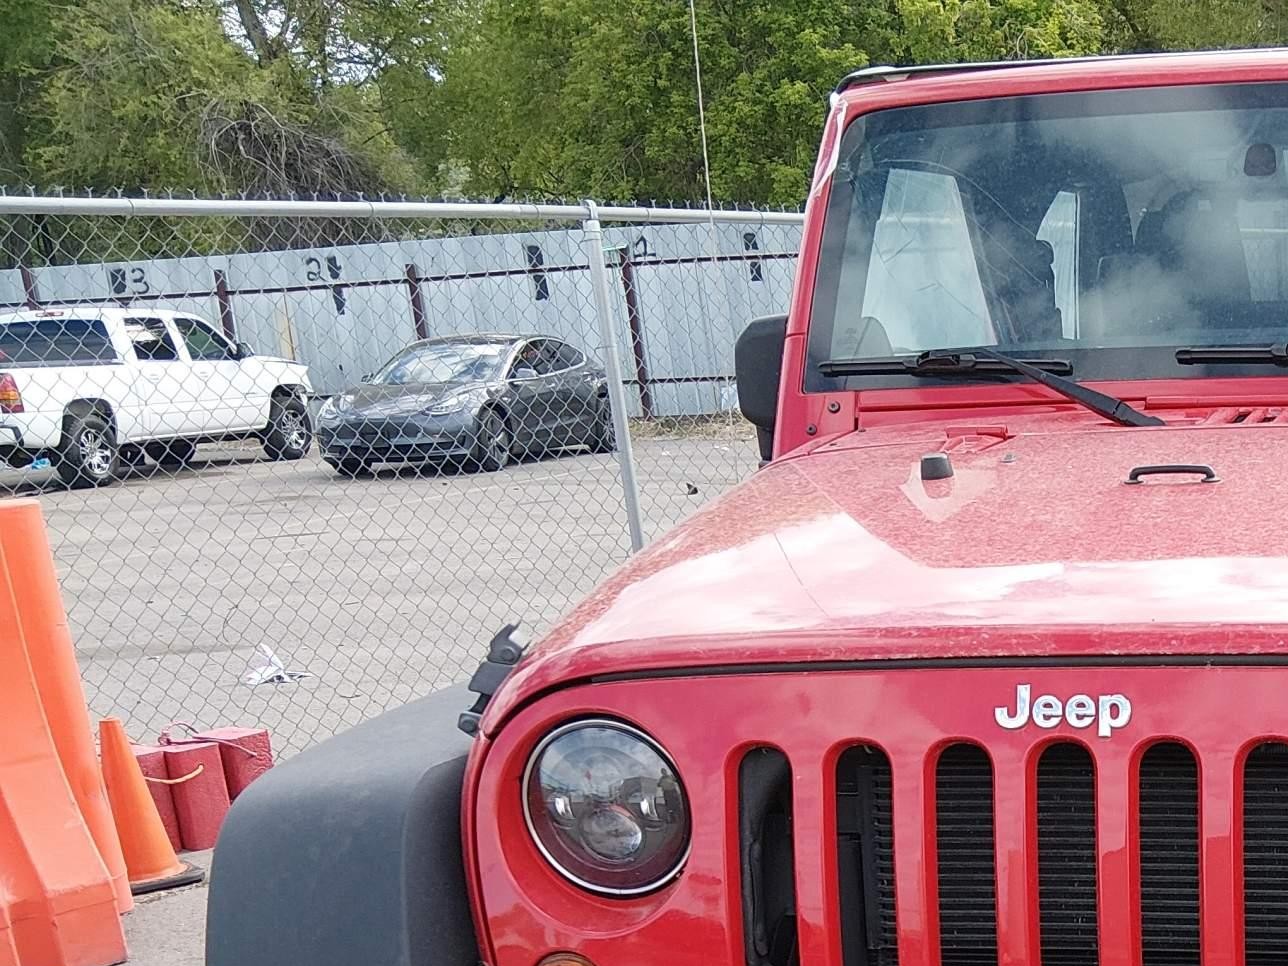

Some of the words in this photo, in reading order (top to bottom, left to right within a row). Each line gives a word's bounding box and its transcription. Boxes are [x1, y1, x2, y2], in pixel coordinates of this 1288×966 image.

[131, 267, 150, 295] 3
[306, 257, 327, 282] 2
[994, 684, 1132, 737] Jeep
